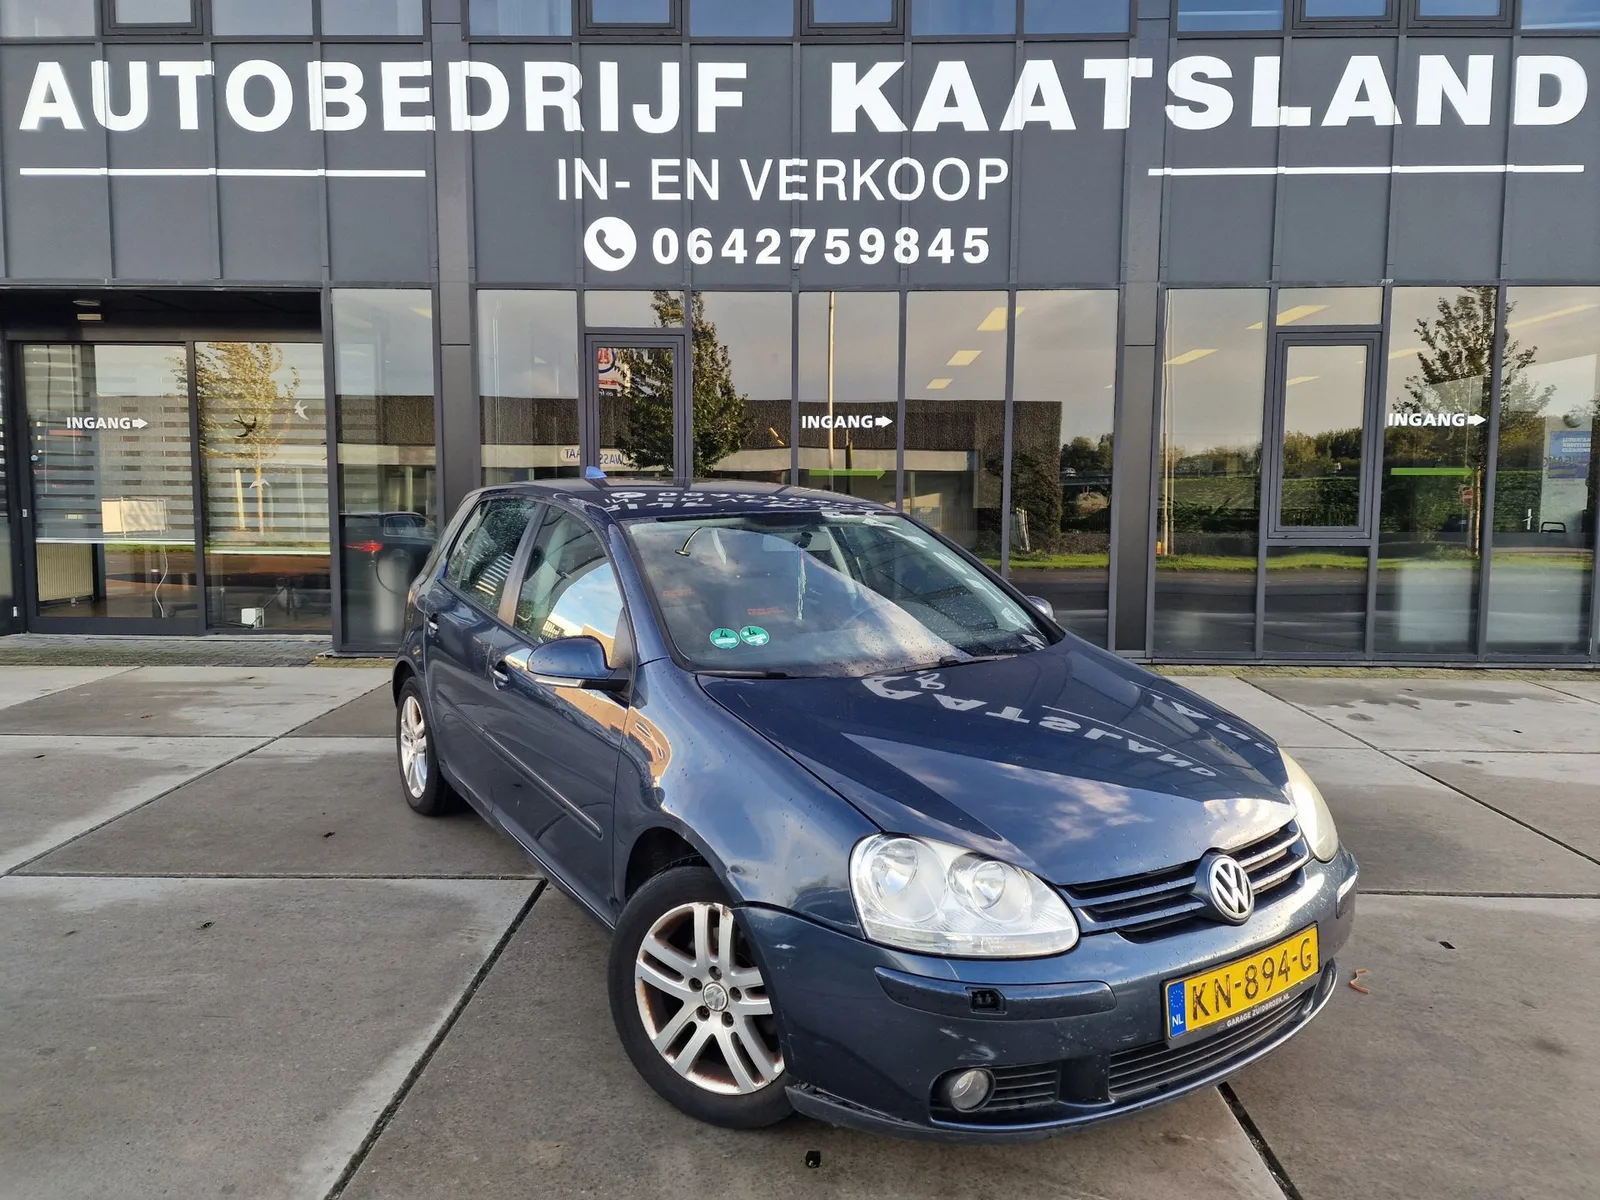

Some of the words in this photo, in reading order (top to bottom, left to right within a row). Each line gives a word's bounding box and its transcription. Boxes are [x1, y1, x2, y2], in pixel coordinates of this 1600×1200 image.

[20, 59, 747, 134] AUTOBEDRIJF
[831, 54, 1588, 133] KAATSLAND
[558, 157, 631, 201] IN-
[651, 157, 719, 201] EN
[740, 156, 1009, 202] VERKOOP
[652, 226, 990, 265] 0642759845
[67, 416, 131, 429] INGANG
[802, 415, 873, 429] INGANG
[1388, 412, 1466, 427] INGANG
[1192, 938, 1312, 1021] KN-894-G
[1171, 1013, 1184, 1028] NL
[1226, 1011, 1252, 1027] GARAGE
[1252, 993, 1290, 1016] ZUIDBROEK.NL
